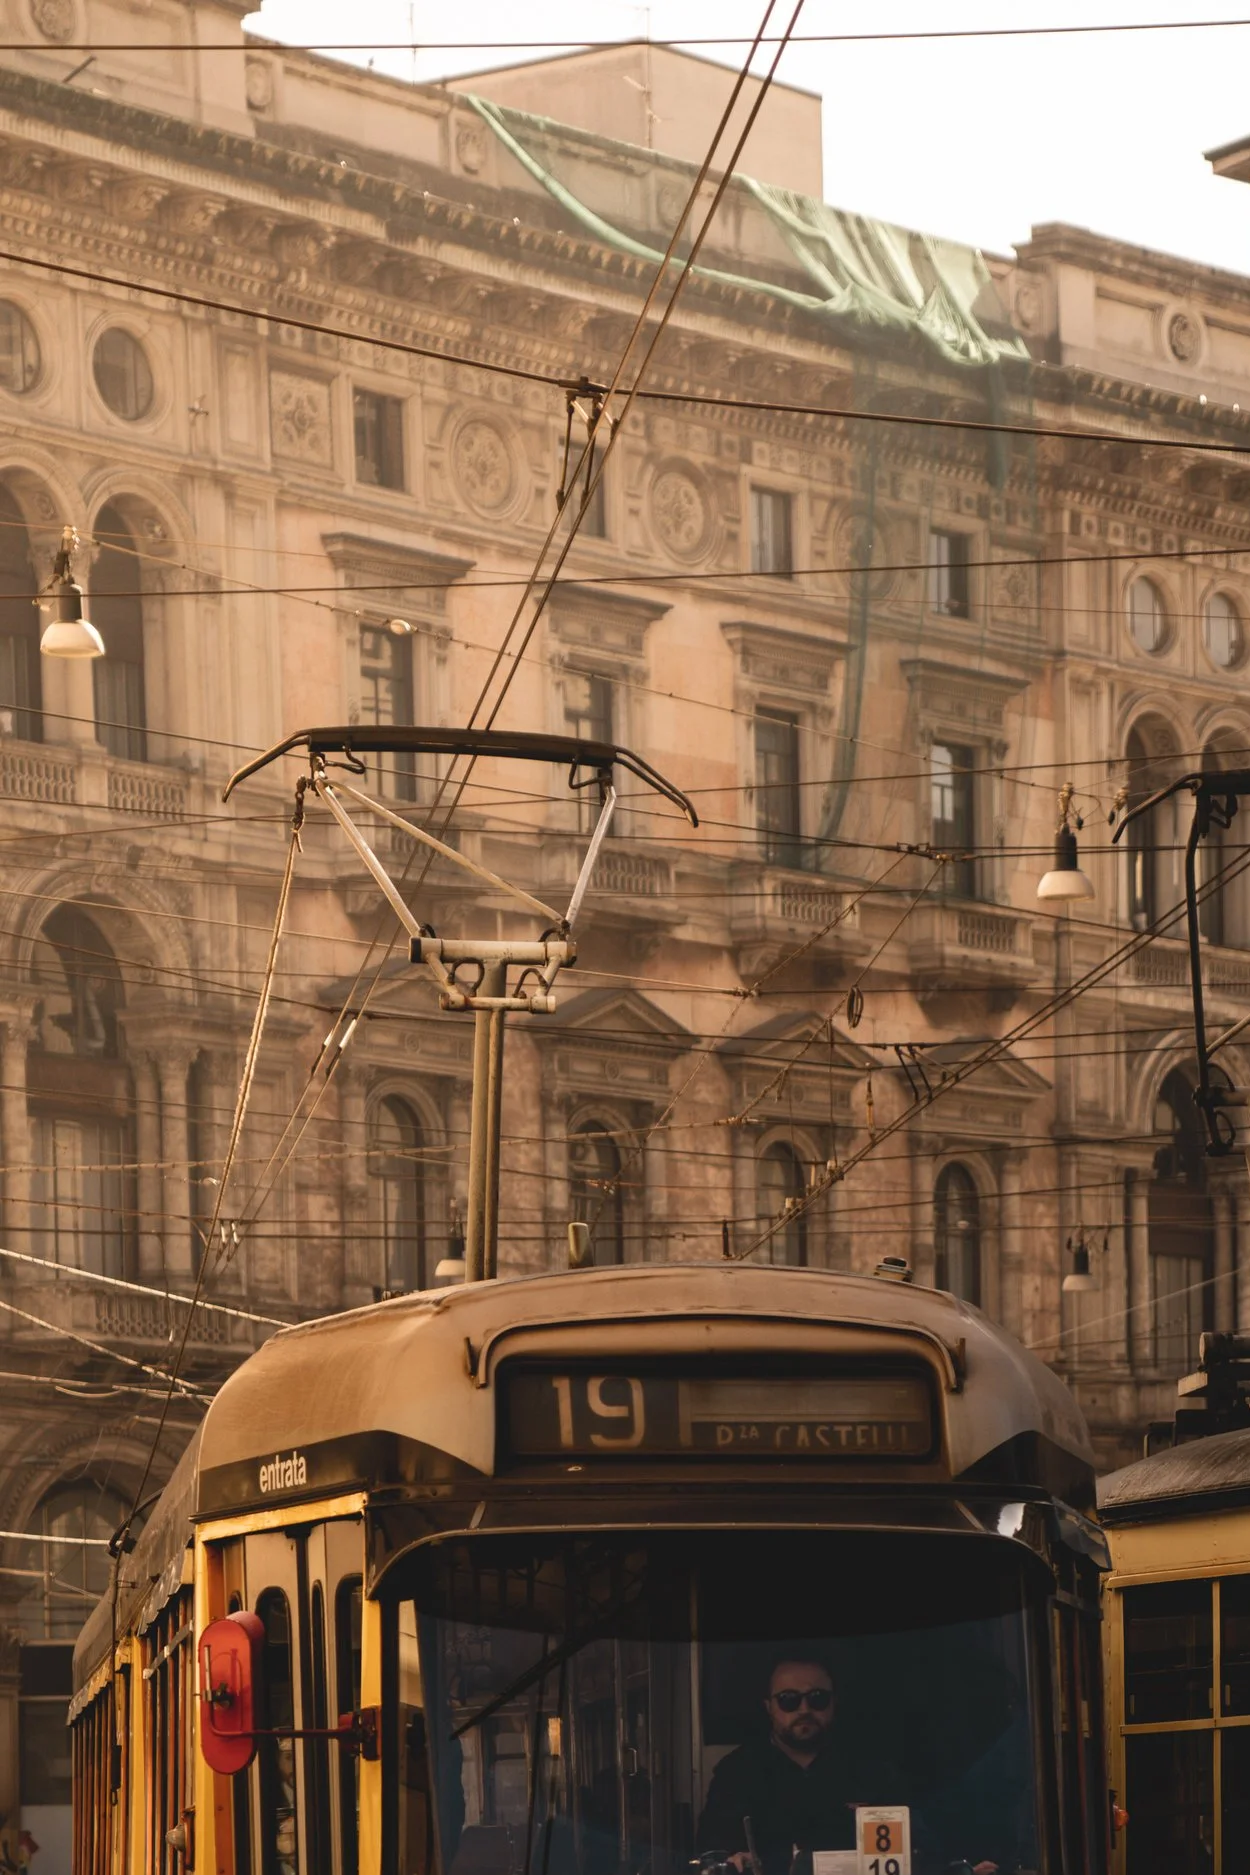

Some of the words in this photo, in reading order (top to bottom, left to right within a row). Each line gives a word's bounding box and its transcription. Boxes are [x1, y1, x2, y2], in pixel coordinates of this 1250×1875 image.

[550, 1376, 646, 1449] 19
[259, 1450, 307, 1493] entrata
[876, 1824, 891, 1852] 8
